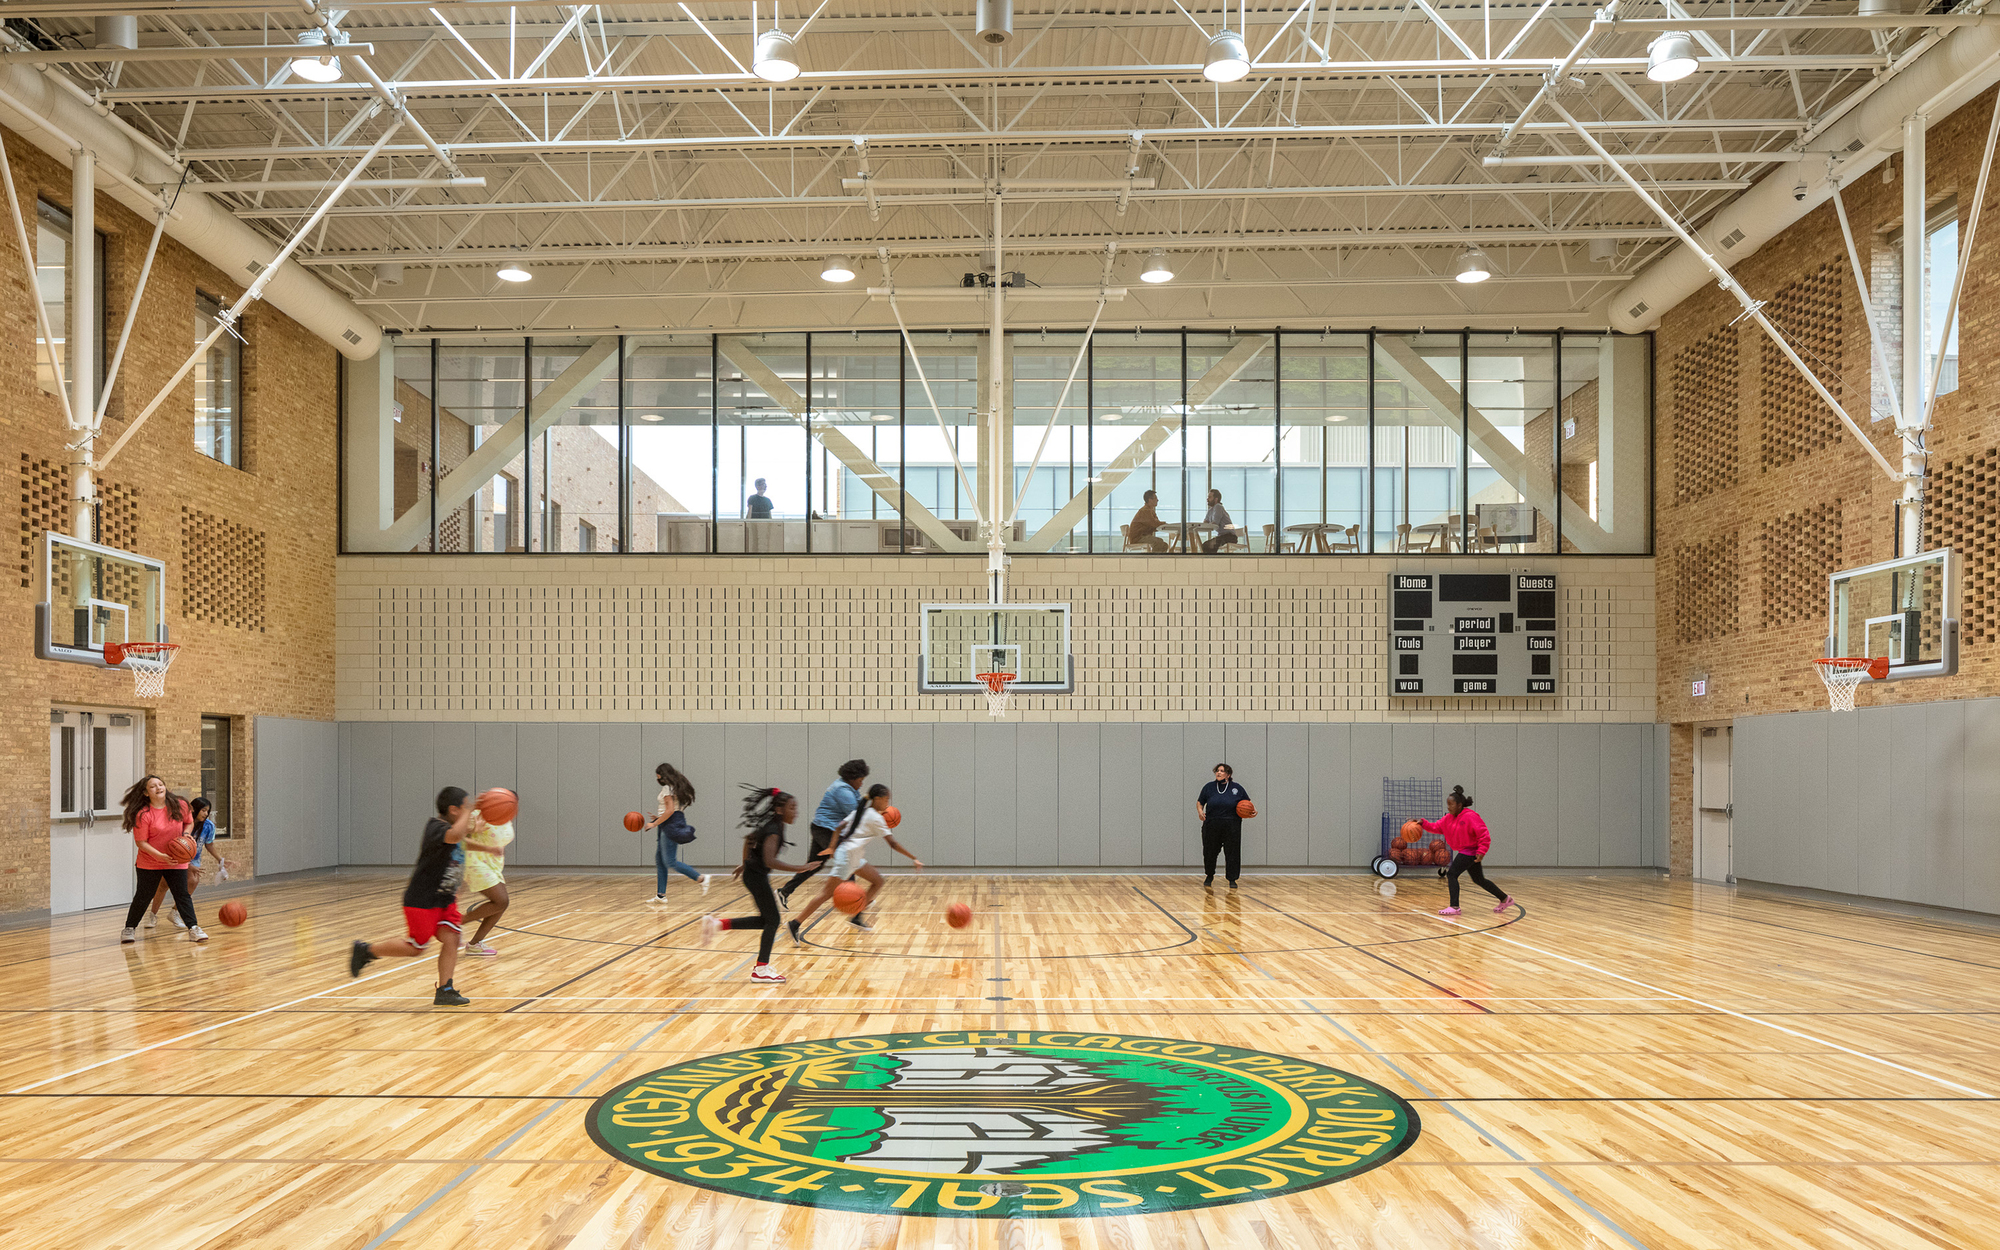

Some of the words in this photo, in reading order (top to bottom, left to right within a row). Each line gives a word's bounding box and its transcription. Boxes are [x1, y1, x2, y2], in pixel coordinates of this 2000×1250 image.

[1400, 577, 1427, 588] Home
[1519, 577, 1554, 588] Guests
[1459, 618, 1491, 631] period
[1459, 637, 1491, 650] player
[1400, 681, 1419, 690] won
[1463, 681, 1488, 693] game
[1532, 681, 1551, 691] won
[923, 1032, 1216, 1056] CHICAGO
[611, 1038, 890, 1128] ORGANIZED
[1142, 1060, 1267, 1099] HORTUS
[1217, 1055, 1379, 1101] PARK
[1229, 1101, 1273, 1114] IN
[1175, 1116, 1270, 1150] URBE
[1176, 1107, 1396, 1199] DISTRICT
[627, 1133, 835, 1195] 1934
[873, 1178, 1144, 1211] SEAL
